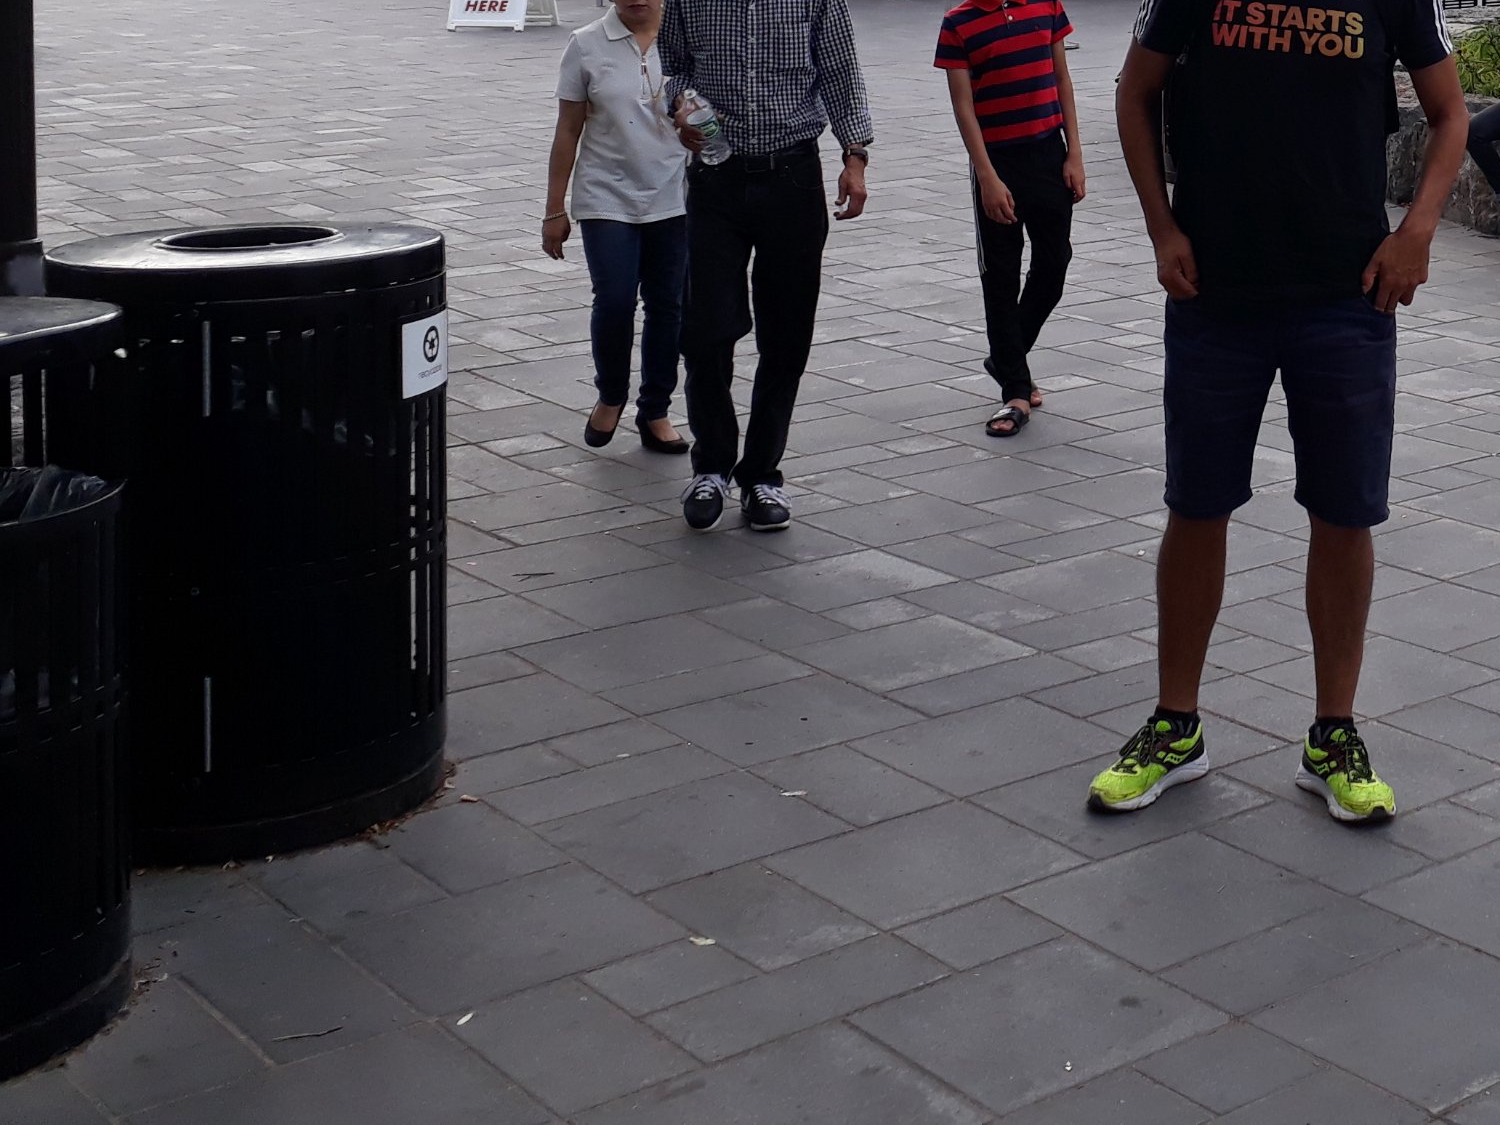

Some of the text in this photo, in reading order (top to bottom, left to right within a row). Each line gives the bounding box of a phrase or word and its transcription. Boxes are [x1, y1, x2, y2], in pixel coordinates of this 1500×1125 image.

[464, 0, 509, 12] HERE
[1213, 0, 1364, 35] IT STARTS
[1211, 22, 1365, 60] WITH YOU
